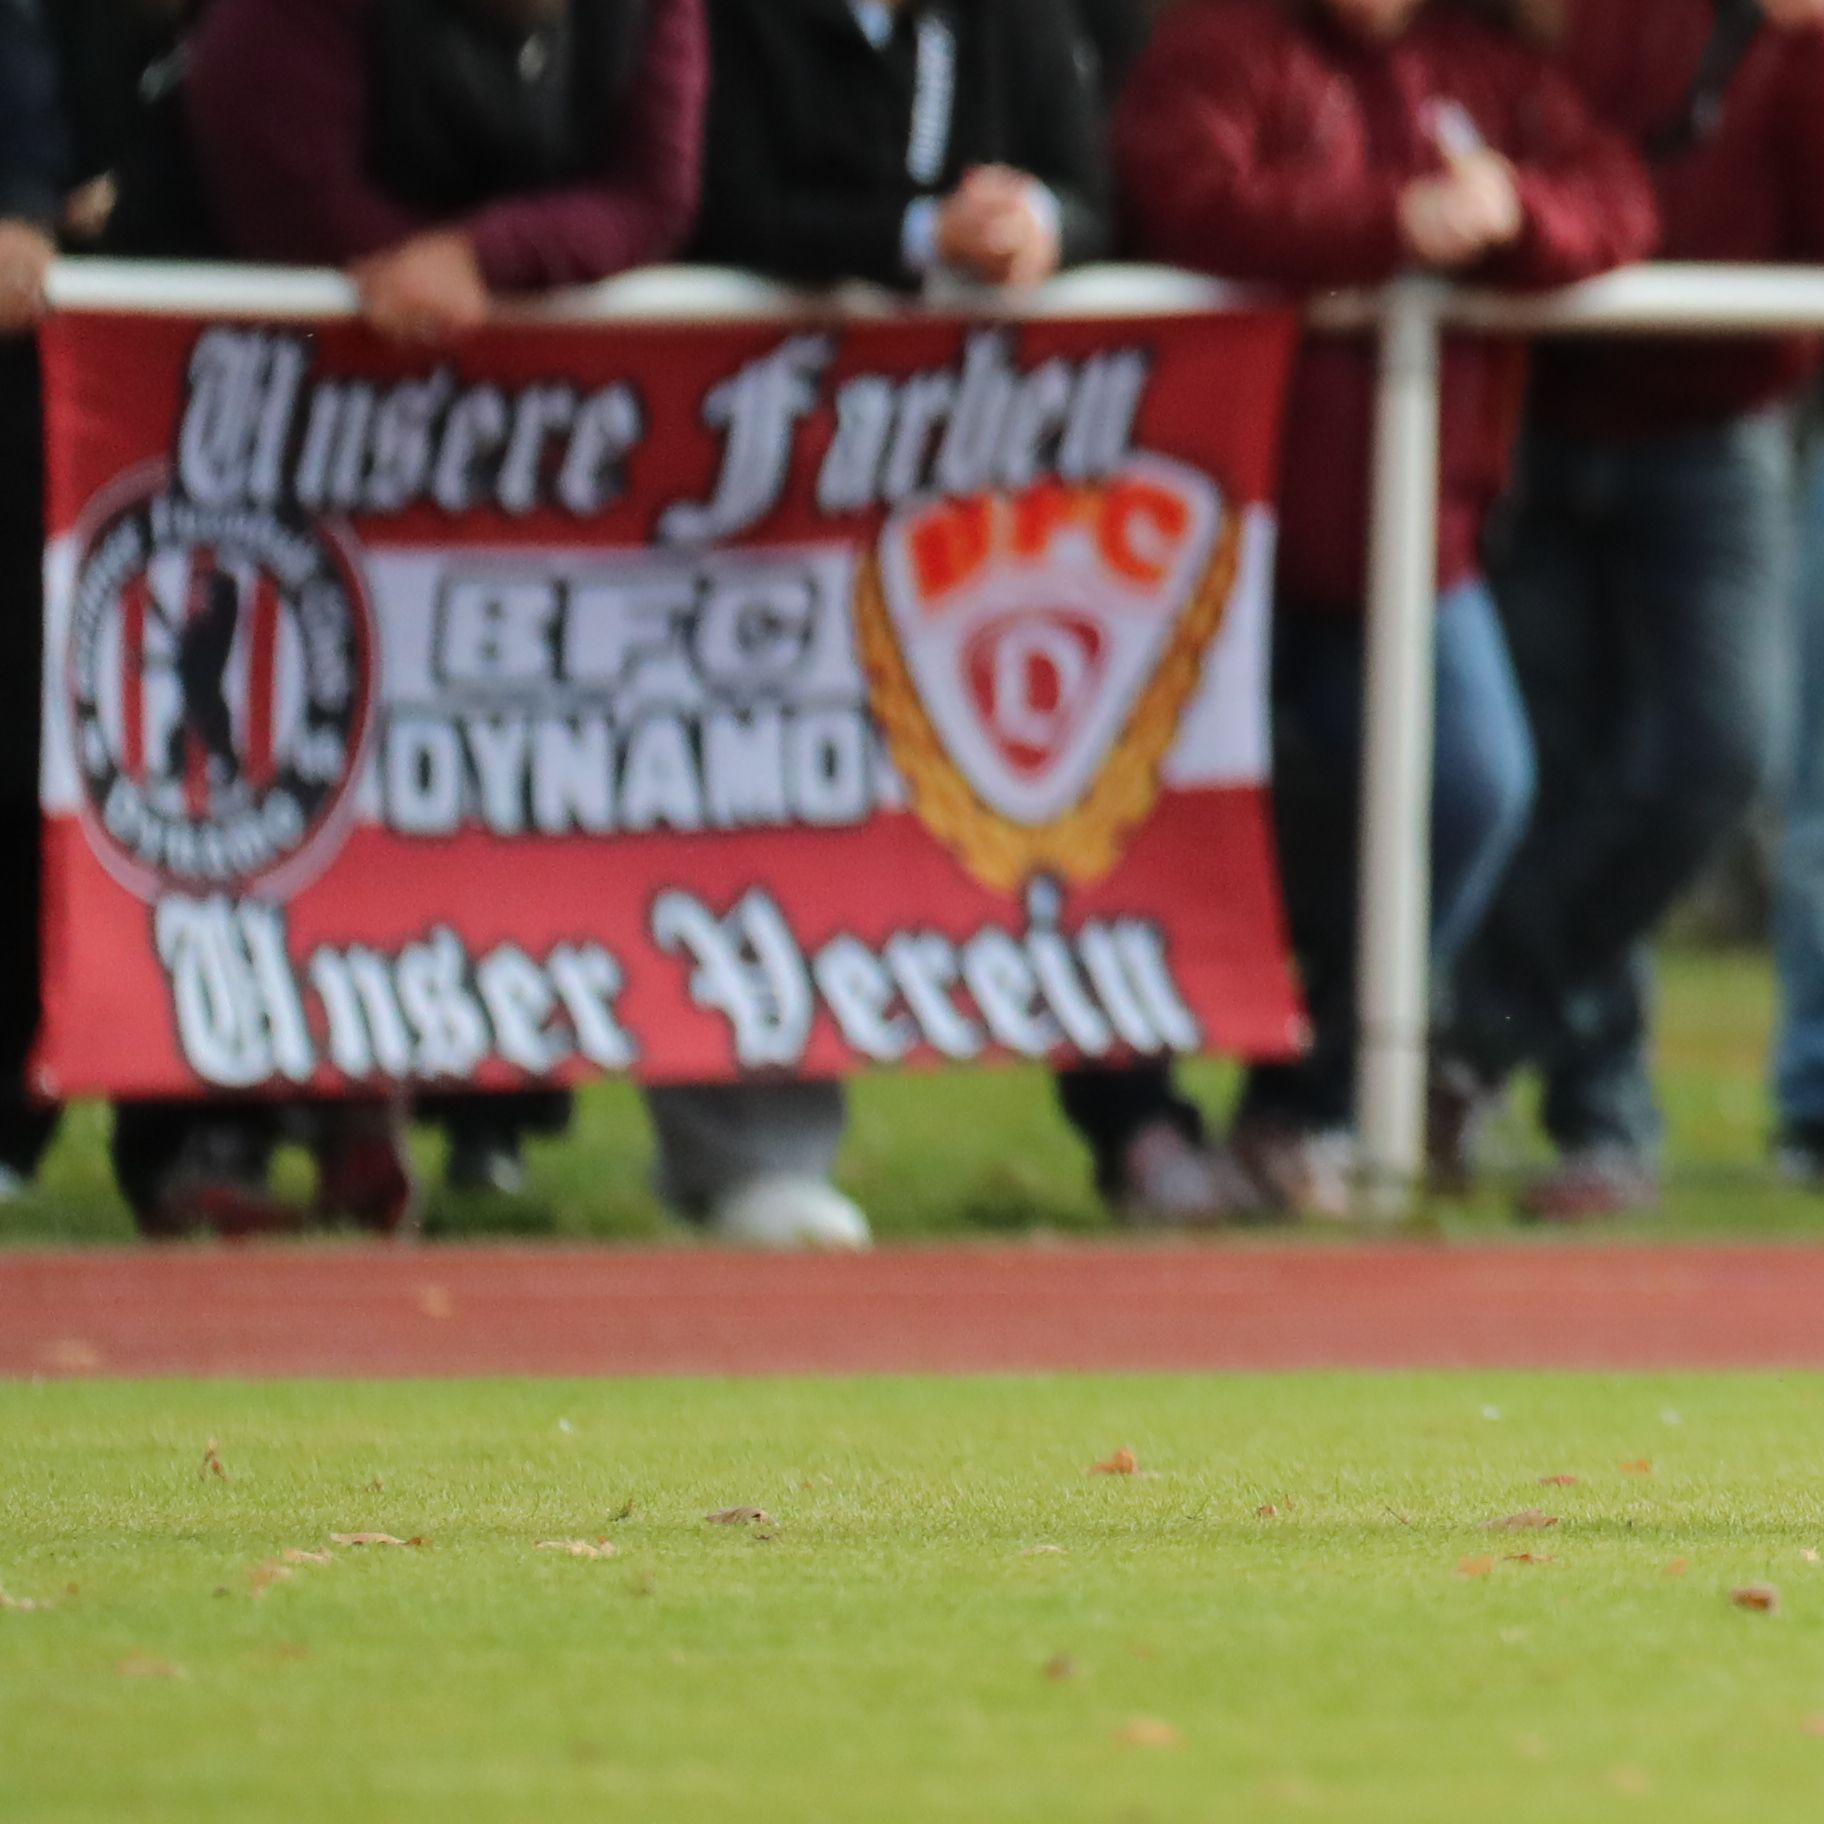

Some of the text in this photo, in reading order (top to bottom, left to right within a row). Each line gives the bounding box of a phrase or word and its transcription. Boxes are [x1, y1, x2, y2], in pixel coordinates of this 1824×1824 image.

[178, 326, 1150, 546] Unsere Farben
[438, 576, 816, 682] BFC
[382, 704, 872, 838] DYNAMO
[154, 874, 1204, 1086] Unser Verein
